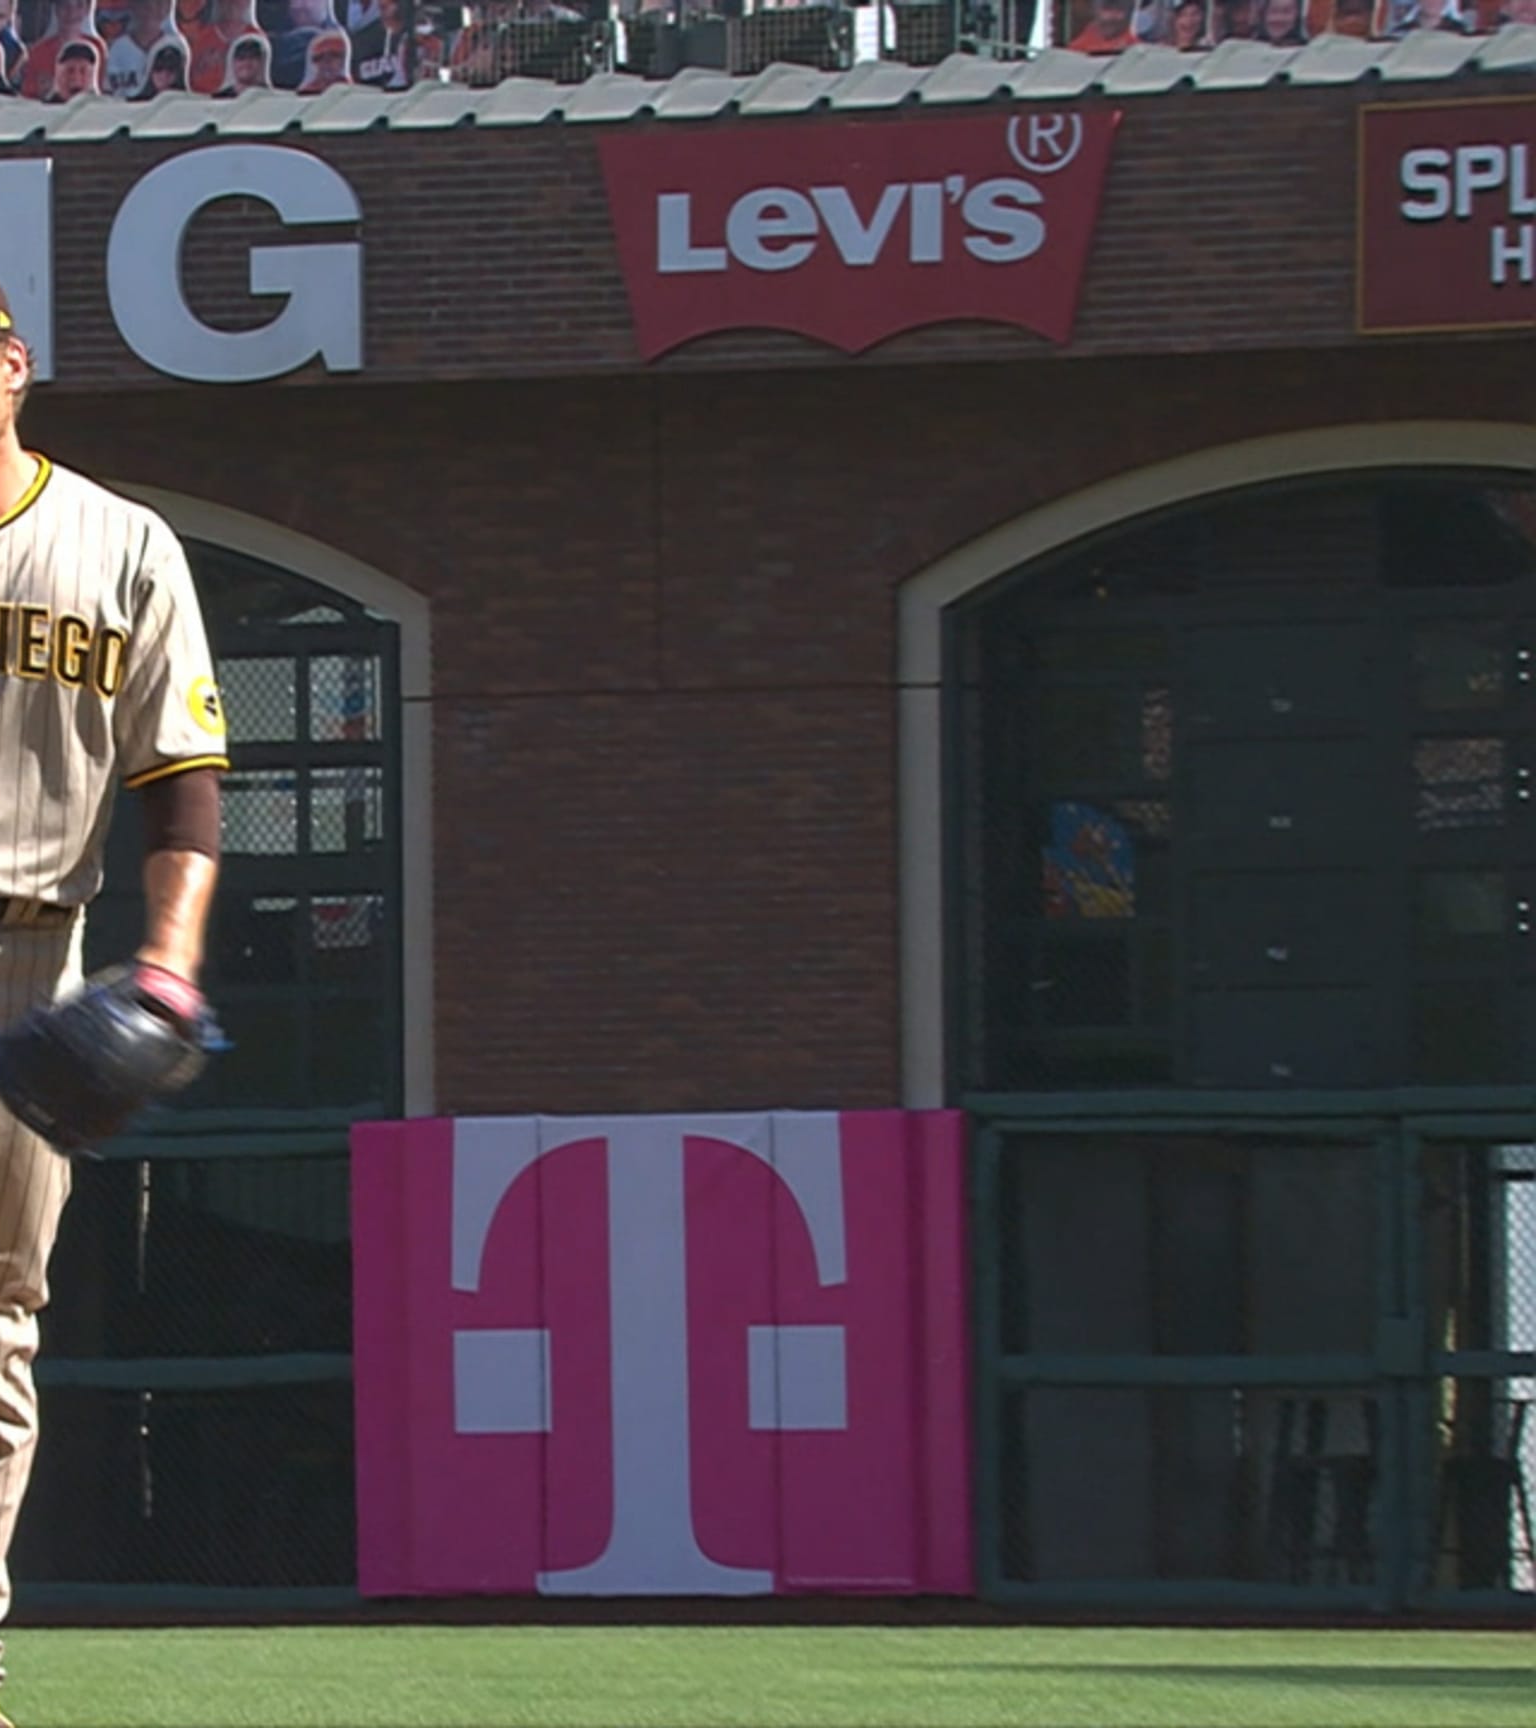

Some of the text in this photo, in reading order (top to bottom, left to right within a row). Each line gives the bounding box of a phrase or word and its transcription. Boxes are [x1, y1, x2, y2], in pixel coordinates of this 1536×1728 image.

[1400, 143, 1536, 220] SPL
[1490, 223, 1534, 285] H
[450, 1109, 848, 1597] T
